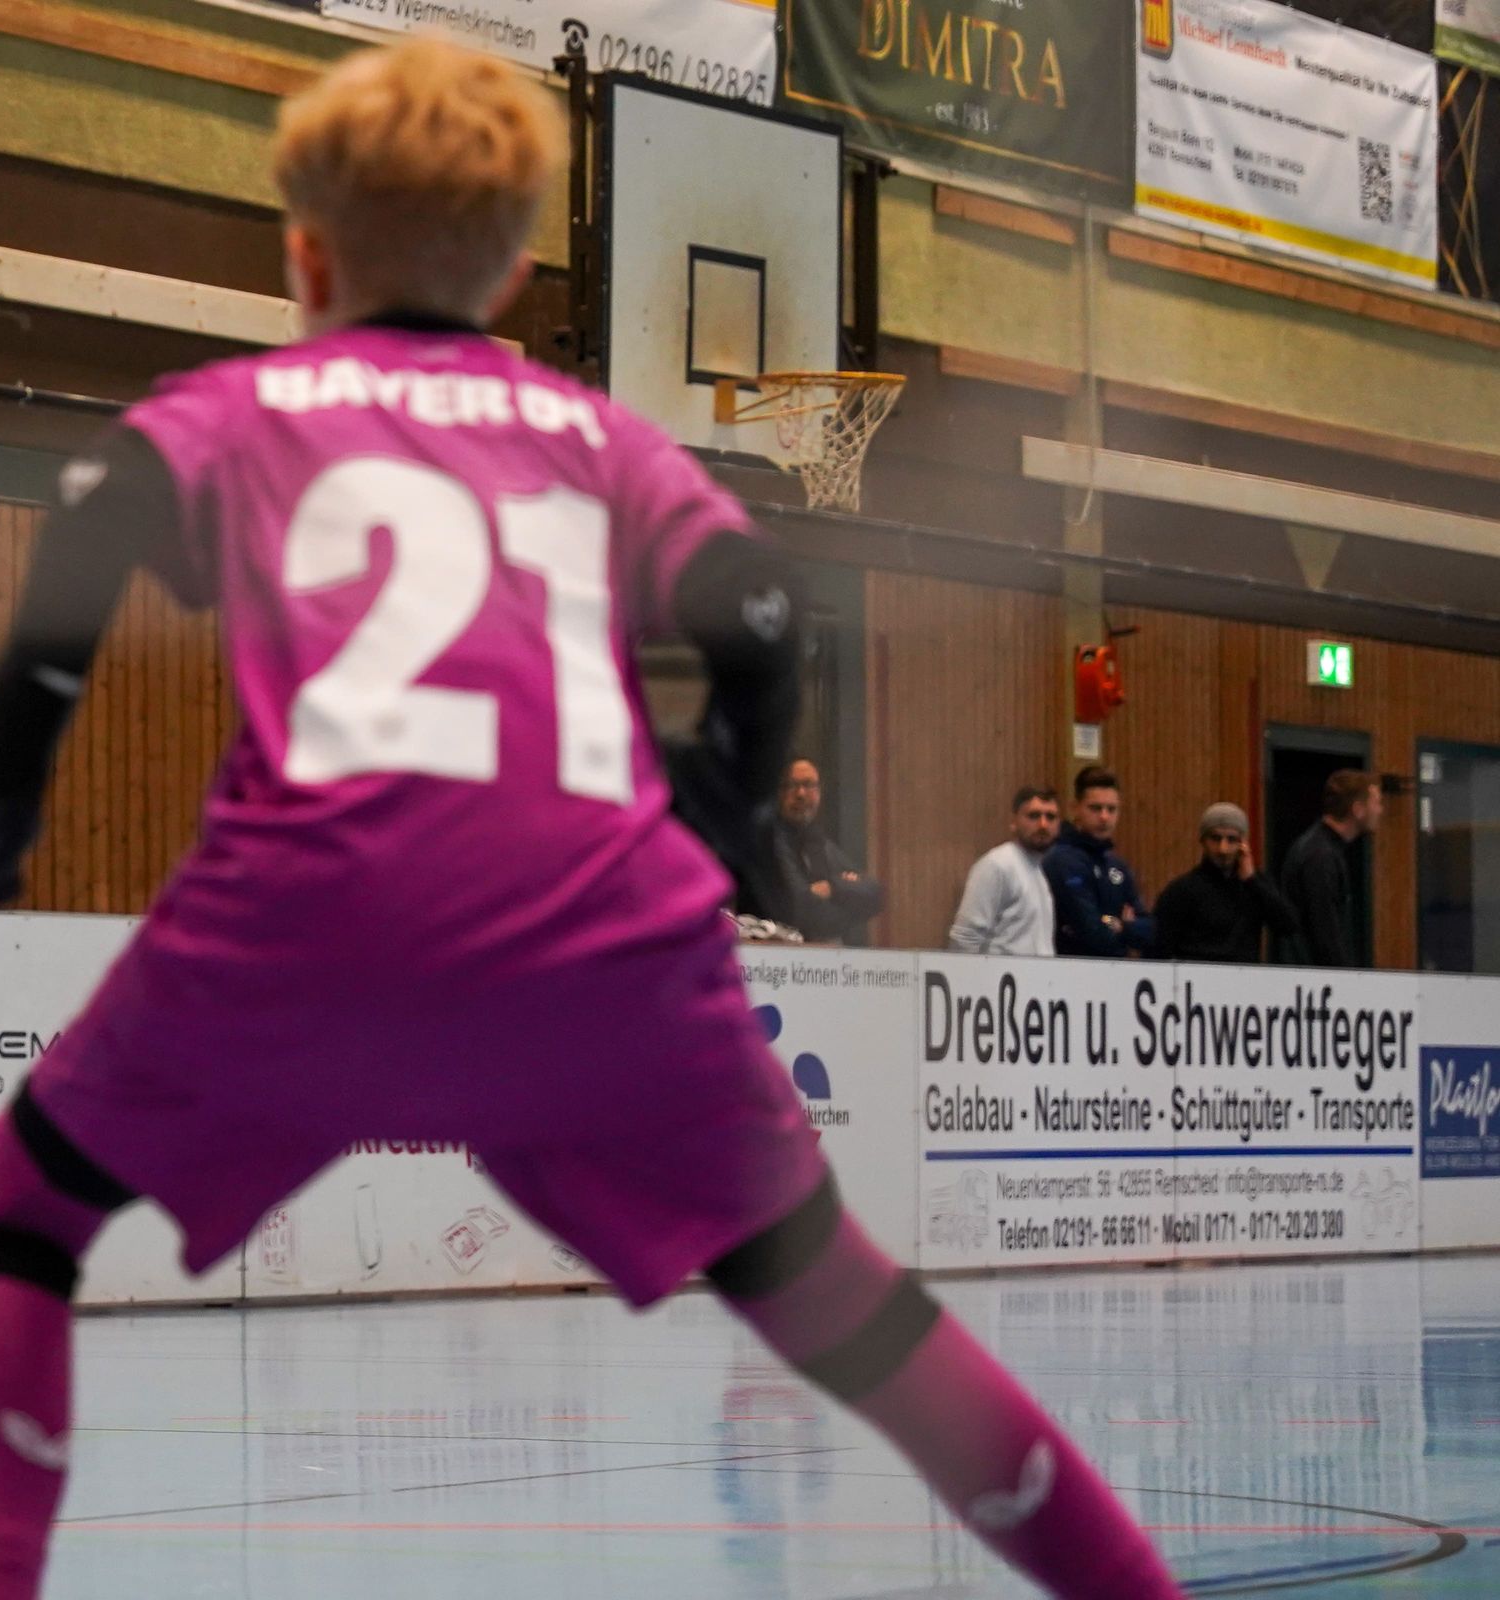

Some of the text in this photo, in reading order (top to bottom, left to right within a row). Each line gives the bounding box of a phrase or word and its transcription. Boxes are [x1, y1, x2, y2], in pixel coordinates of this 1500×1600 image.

[599, 34, 674, 83] 02196
[696, 58, 767, 102] 92825
[857, 0, 1067, 110] DIMITRA
[256, 357, 512, 427] BAYER
[283, 450, 635, 806] 21
[739, 959, 788, 990] nanlage
[791, 961, 838, 986] können
[841, 963, 860, 987] Sie
[925, 970, 1413, 1091] Dreßen u. Schwerdtfeger
[926, 1084, 1014, 1132] Galabau
[1035, 1085, 1151, 1131] Natursteine
[1171, 1085, 1292, 1142] Schüttgüter
[1310, 1087, 1414, 1141] Transporte
[998, 1217, 1050, 1249] Telefon
[1162, 1212, 1199, 1244] Mobil
[1204, 1212, 1236, 1242] 0171
